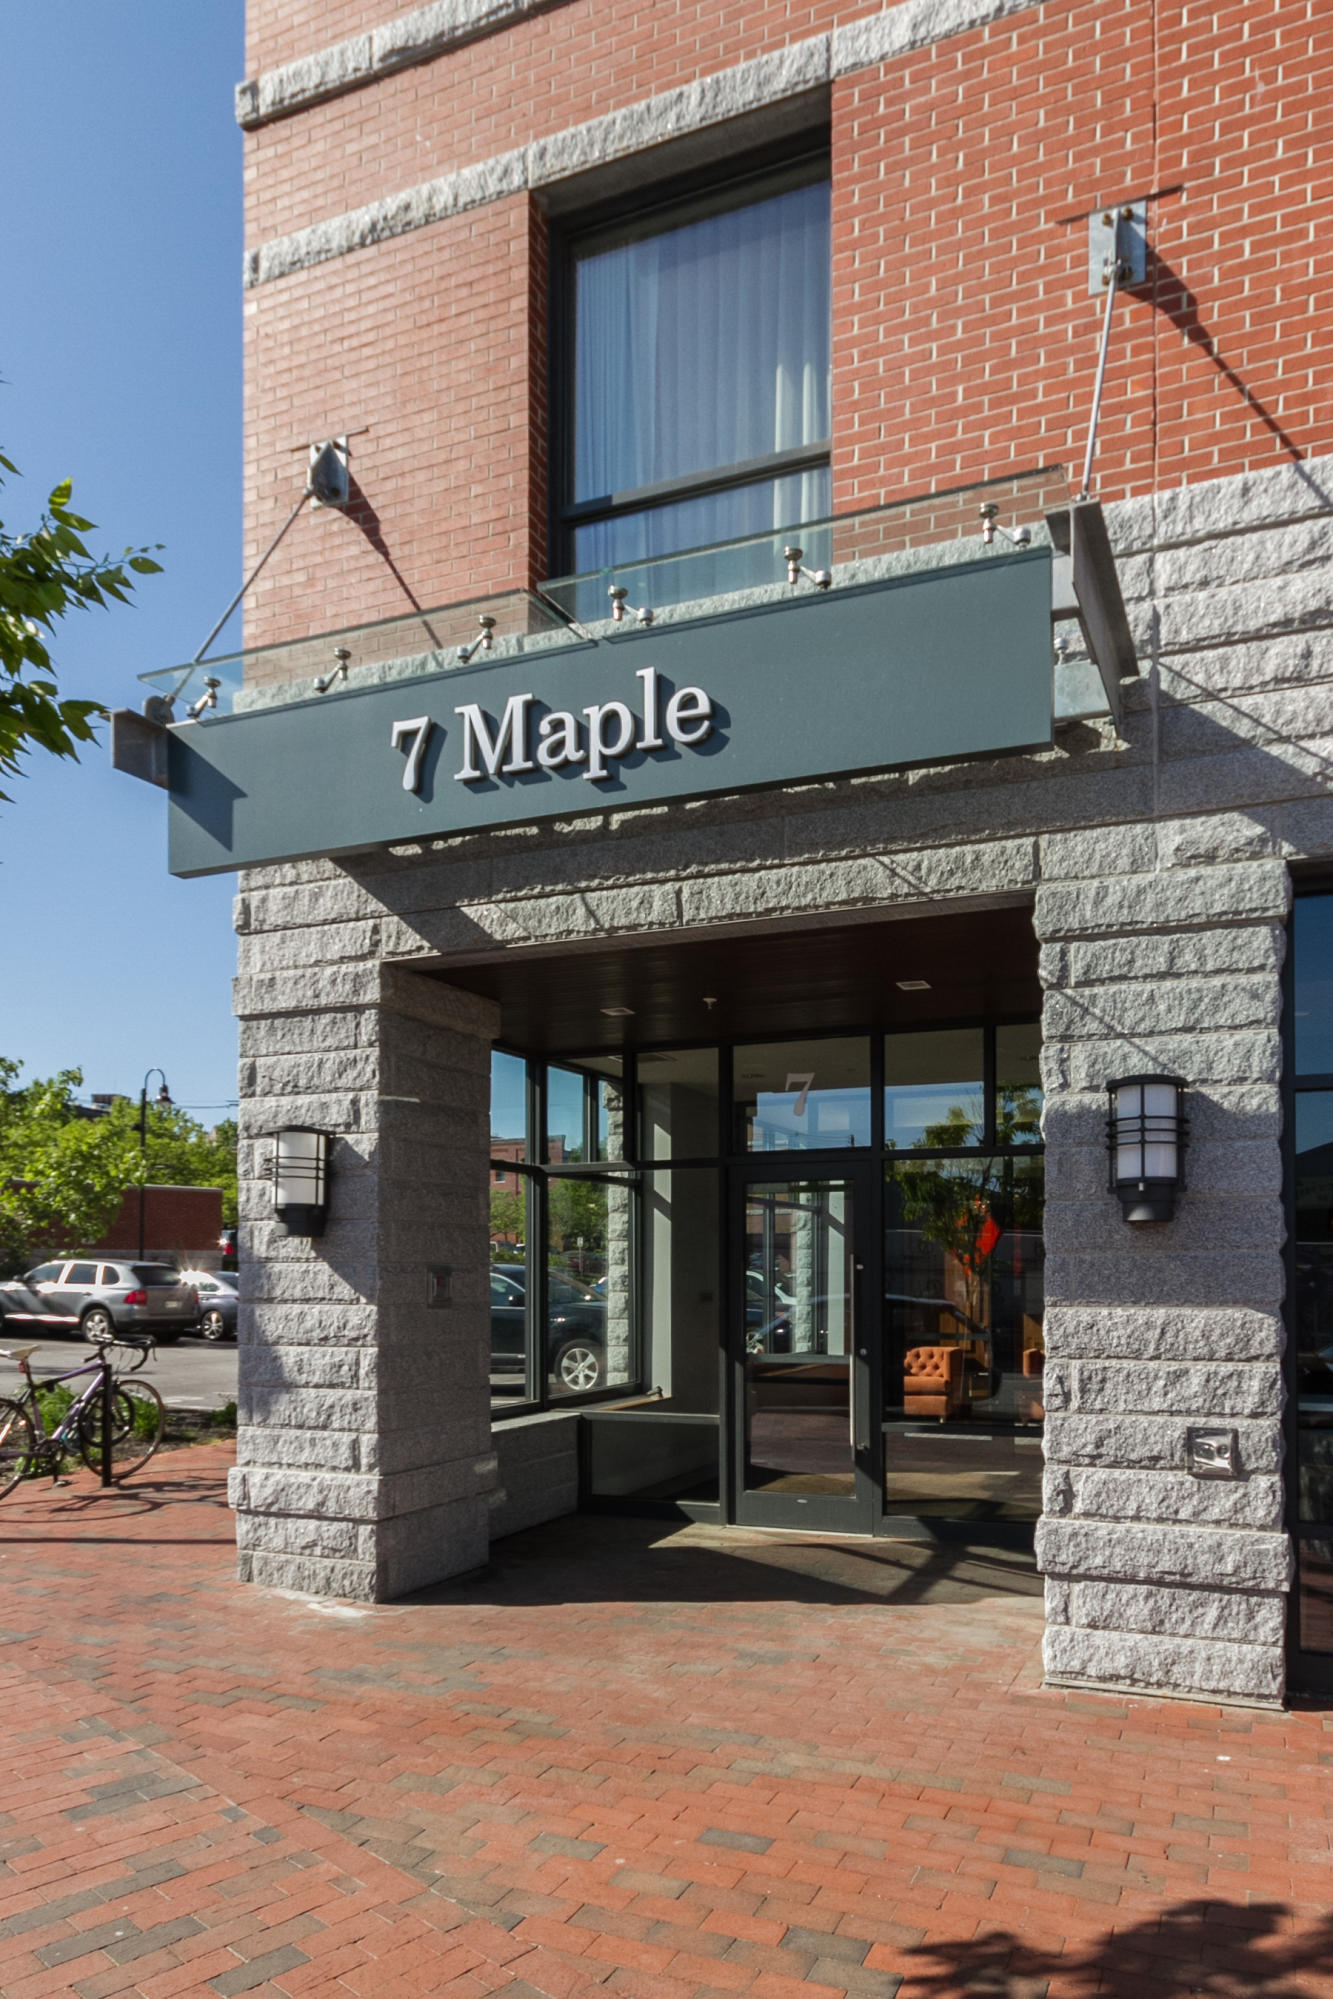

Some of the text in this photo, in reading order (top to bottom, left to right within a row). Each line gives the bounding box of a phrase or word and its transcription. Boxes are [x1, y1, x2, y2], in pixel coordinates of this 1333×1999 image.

[391, 666, 712, 792] 7 Maple
[785, 1072, 815, 1117] 7
